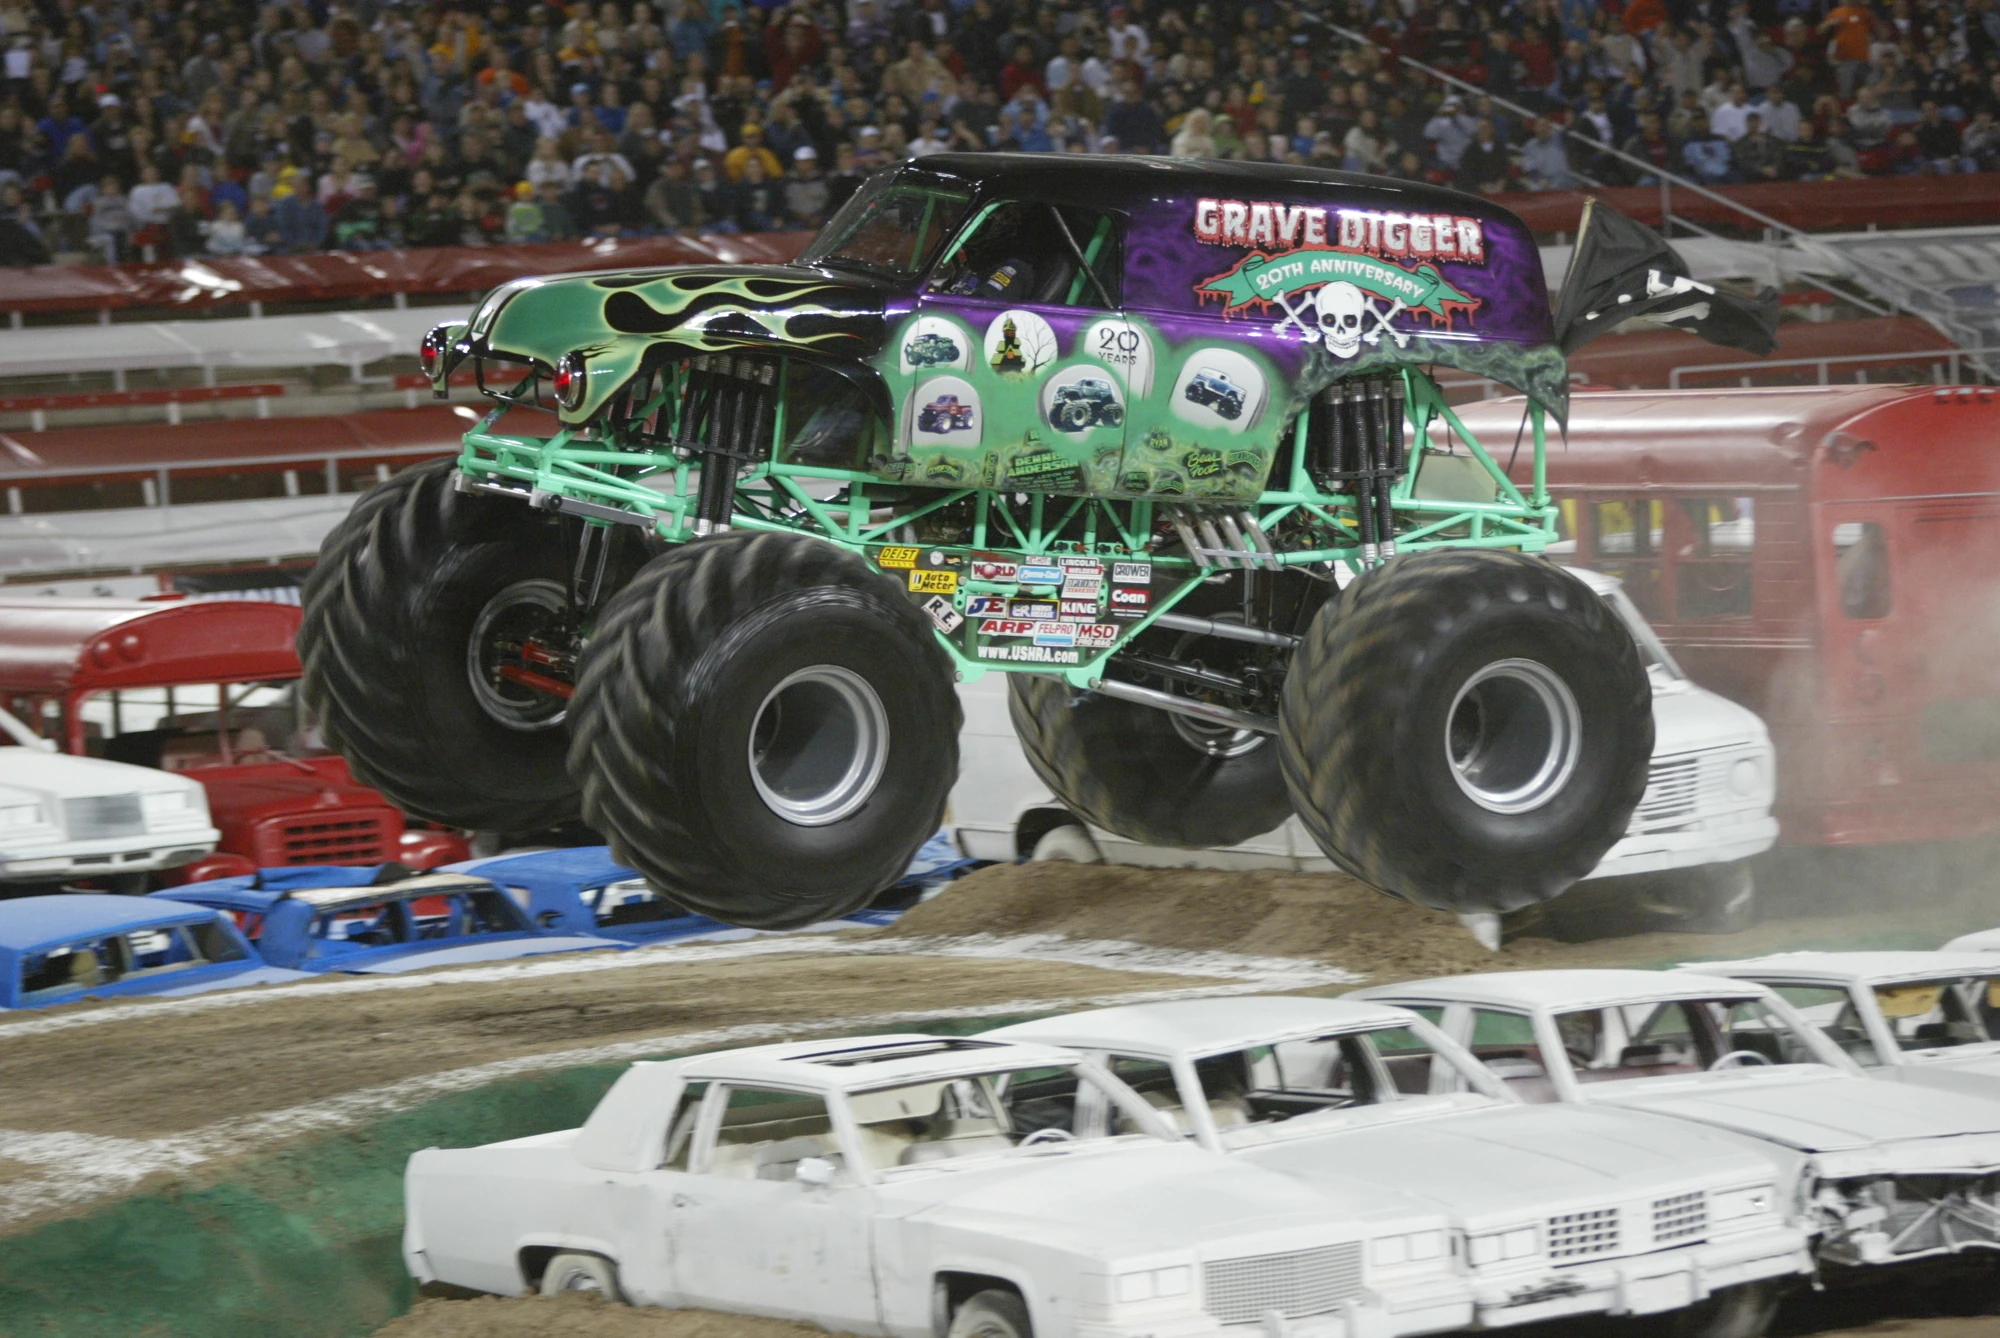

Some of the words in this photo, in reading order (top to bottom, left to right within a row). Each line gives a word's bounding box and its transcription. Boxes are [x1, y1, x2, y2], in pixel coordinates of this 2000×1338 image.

[1195, 199, 1327, 247] GRAVE
[1337, 209, 1483, 259] DIGGER
[1256, 262, 1304, 290] 20TH
[1310, 259, 1425, 298] ANNIVERSARY
[1099, 327, 1139, 352] 20
[1098, 351, 1137, 365] YEARS
[882, 548, 917, 560] DEIST
[1060, 557, 1097, 567] LINCOLN
[924, 573, 950, 582] Auto
[1114, 564, 1149, 577] CROWER
[922, 581, 954, 590] Meter
[1112, 589, 1146, 604] Coan
[967, 597, 1006, 615] JE
[1061, 602, 1097, 614] KING
[982, 620, 1034, 633] ARP
[1078, 625, 1115, 639] MSD
[977, 645, 1079, 664] www.USHRA.com
